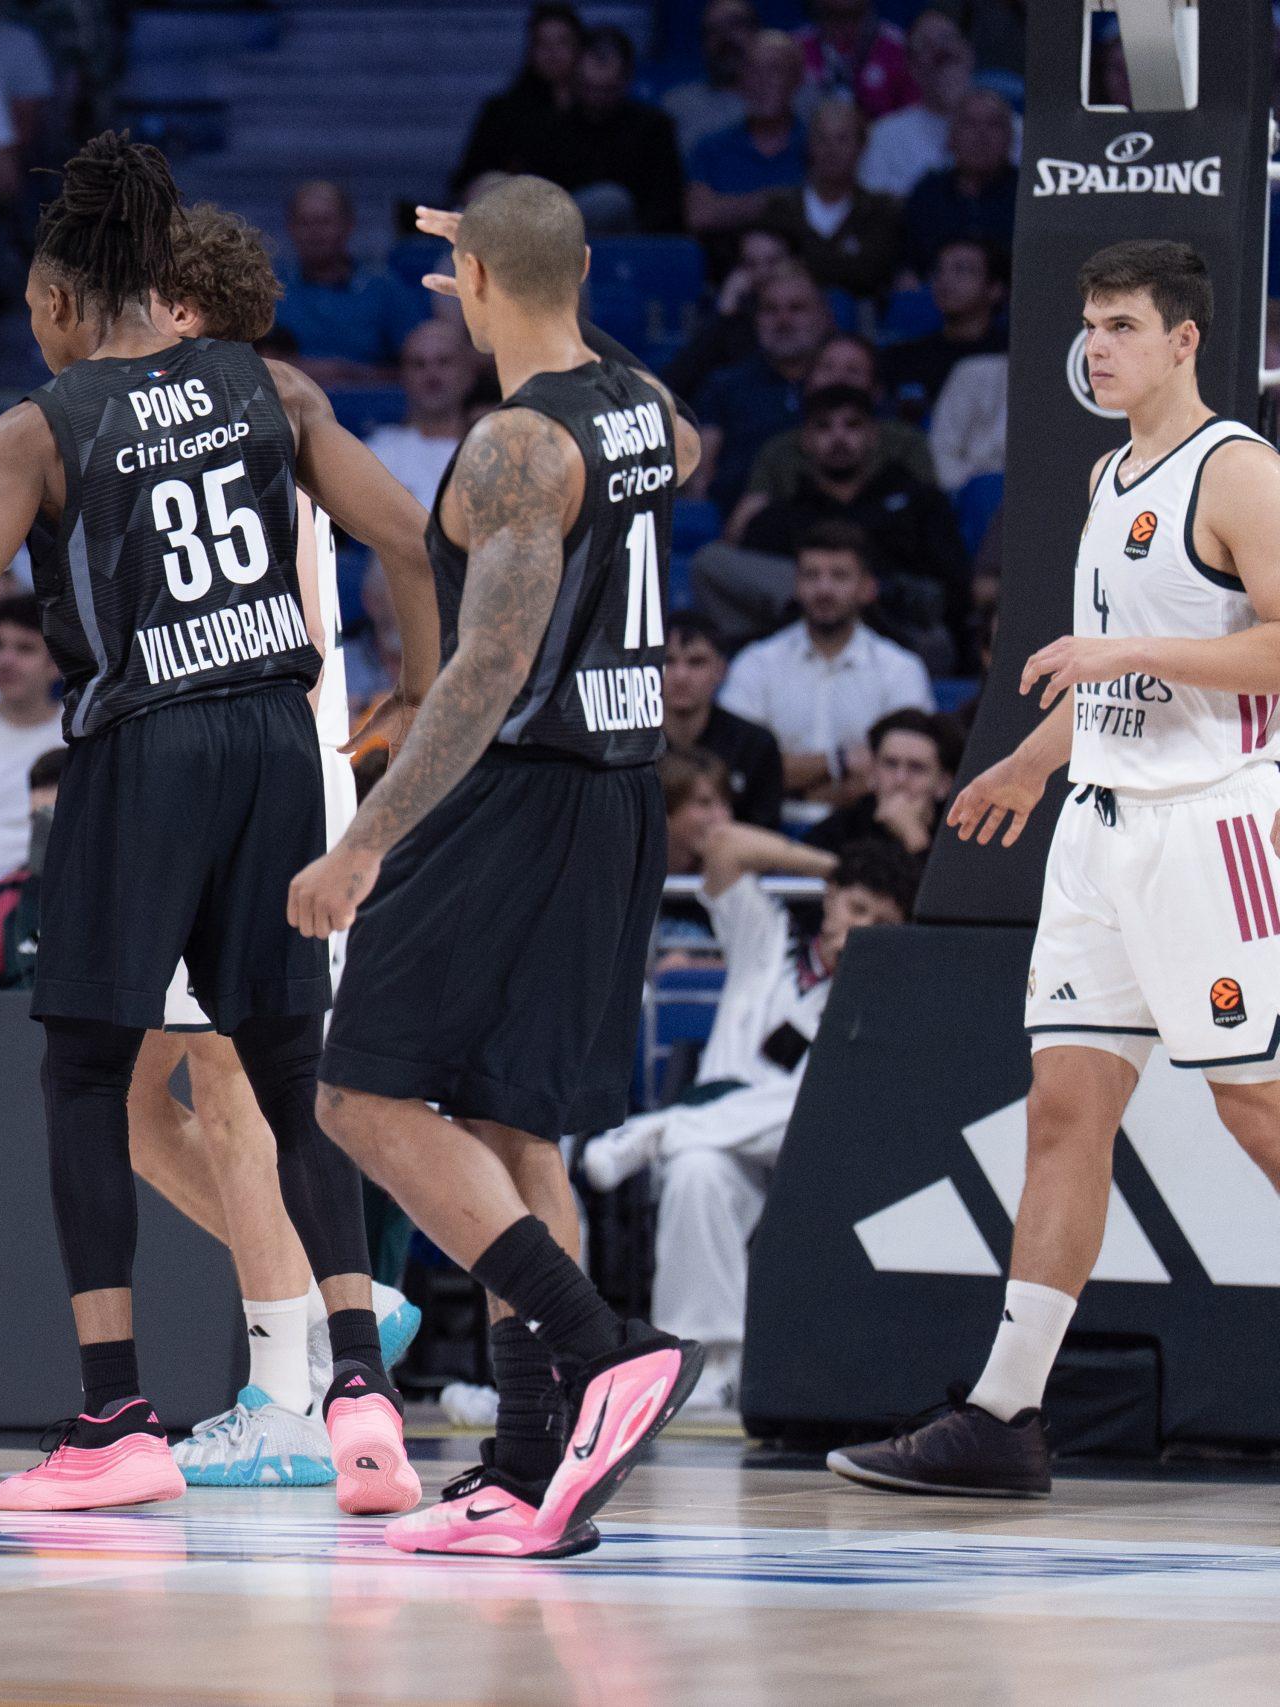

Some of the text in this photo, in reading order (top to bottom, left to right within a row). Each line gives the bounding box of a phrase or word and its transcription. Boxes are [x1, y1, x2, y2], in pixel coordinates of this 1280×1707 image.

[1033, 156, 1221, 197] SPALDING
[128, 378, 213, 431] PONS
[151, 460, 269, 602] 35
[1093, 567, 1110, 634] 4
